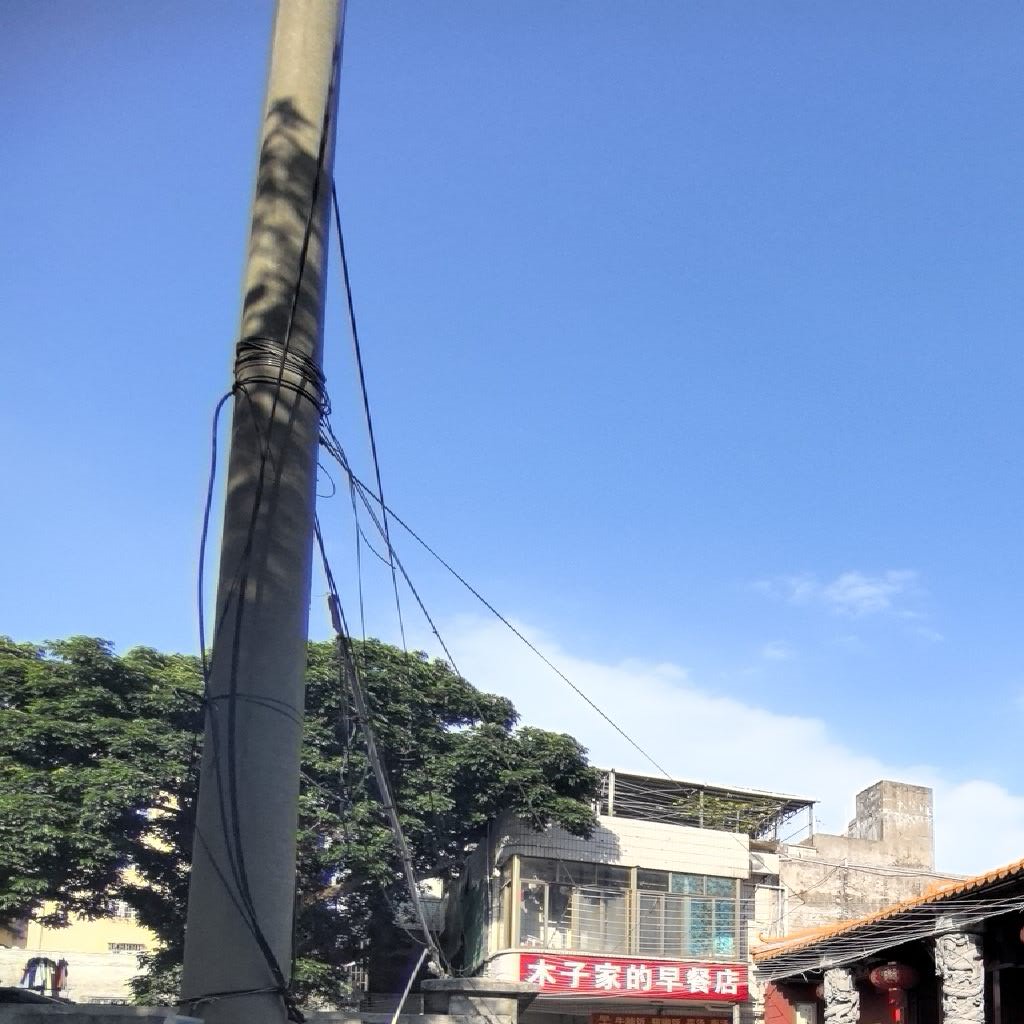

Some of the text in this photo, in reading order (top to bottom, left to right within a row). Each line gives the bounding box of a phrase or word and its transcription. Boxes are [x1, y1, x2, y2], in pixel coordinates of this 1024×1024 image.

[525, 958, 740, 995] 木子家的早餐店
